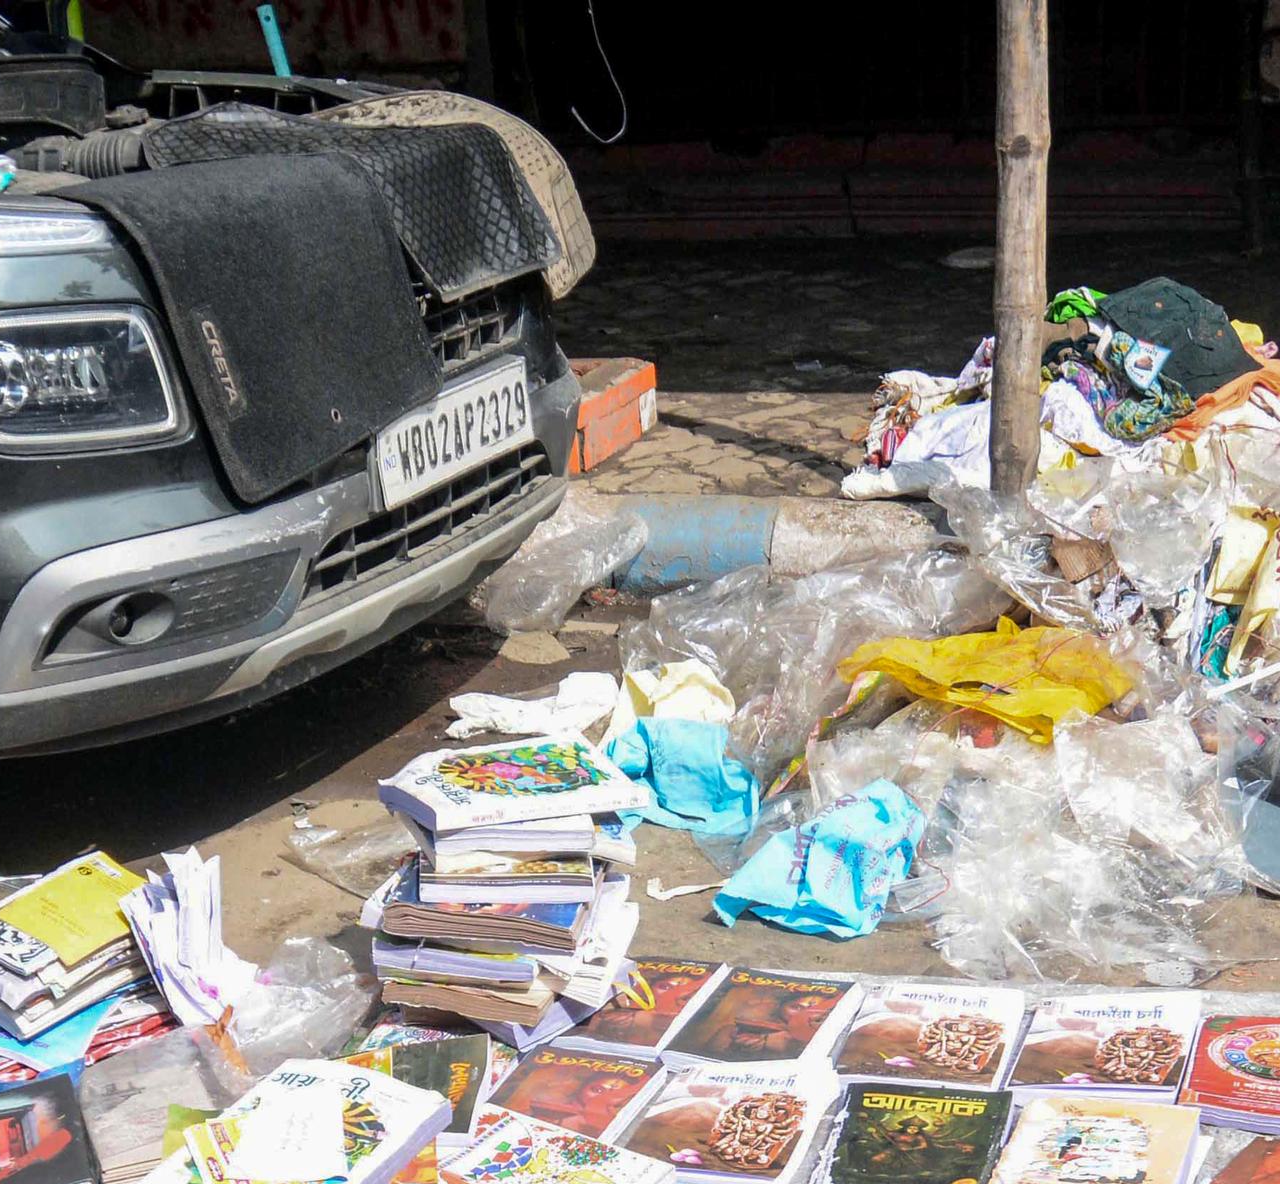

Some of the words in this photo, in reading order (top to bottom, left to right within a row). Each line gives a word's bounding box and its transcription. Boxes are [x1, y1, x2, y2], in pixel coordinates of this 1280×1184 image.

[202, 320, 238, 406] CRETA
[397, 381, 526, 481] WB02AP2329
[862, 1092, 988, 1117] আলোক
